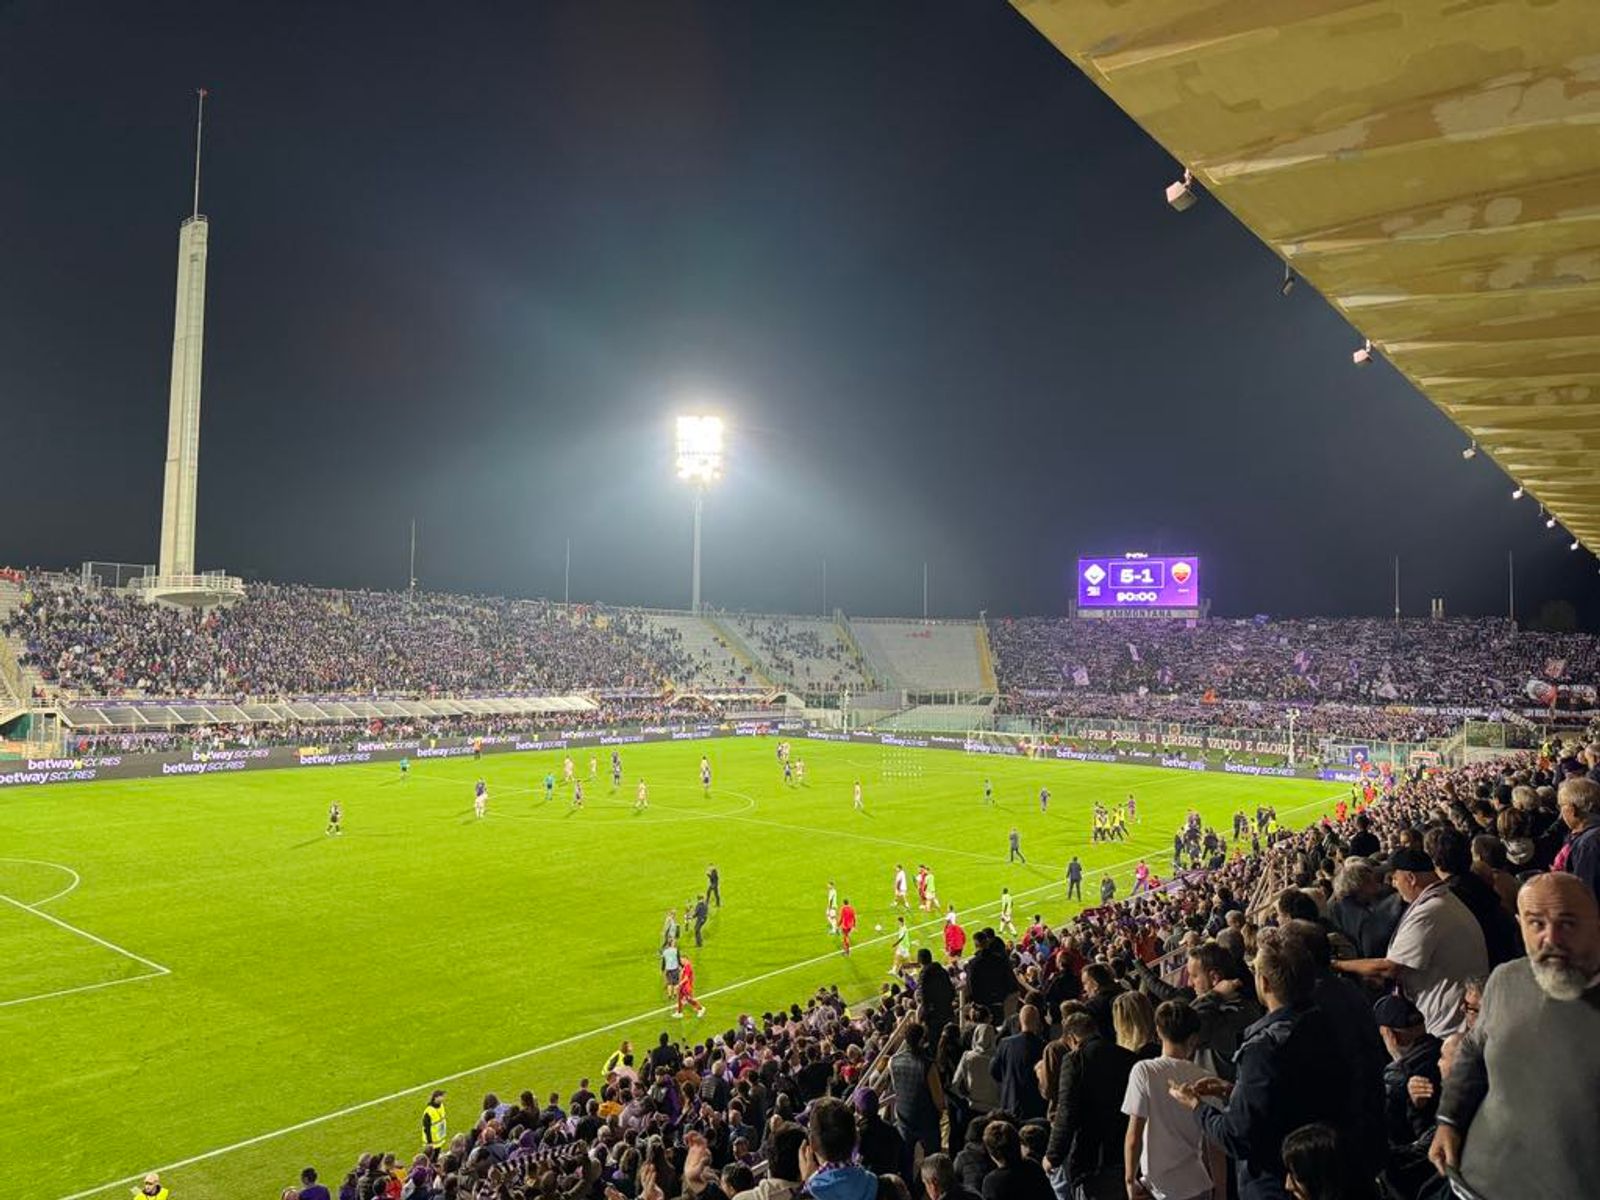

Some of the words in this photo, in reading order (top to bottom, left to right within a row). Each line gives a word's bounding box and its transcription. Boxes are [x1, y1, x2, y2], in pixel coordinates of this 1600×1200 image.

[1120, 568, 1154, 583] 5-1
[1116, 592, 1157, 602] 90:00
[192, 749, 234, 761] btway
[416, 746, 450, 758] betway
[28, 758, 76, 770] betway
[300, 753, 340, 766] betway
[162, 761, 208, 774] betway
[1224, 762, 1261, 776] betway
